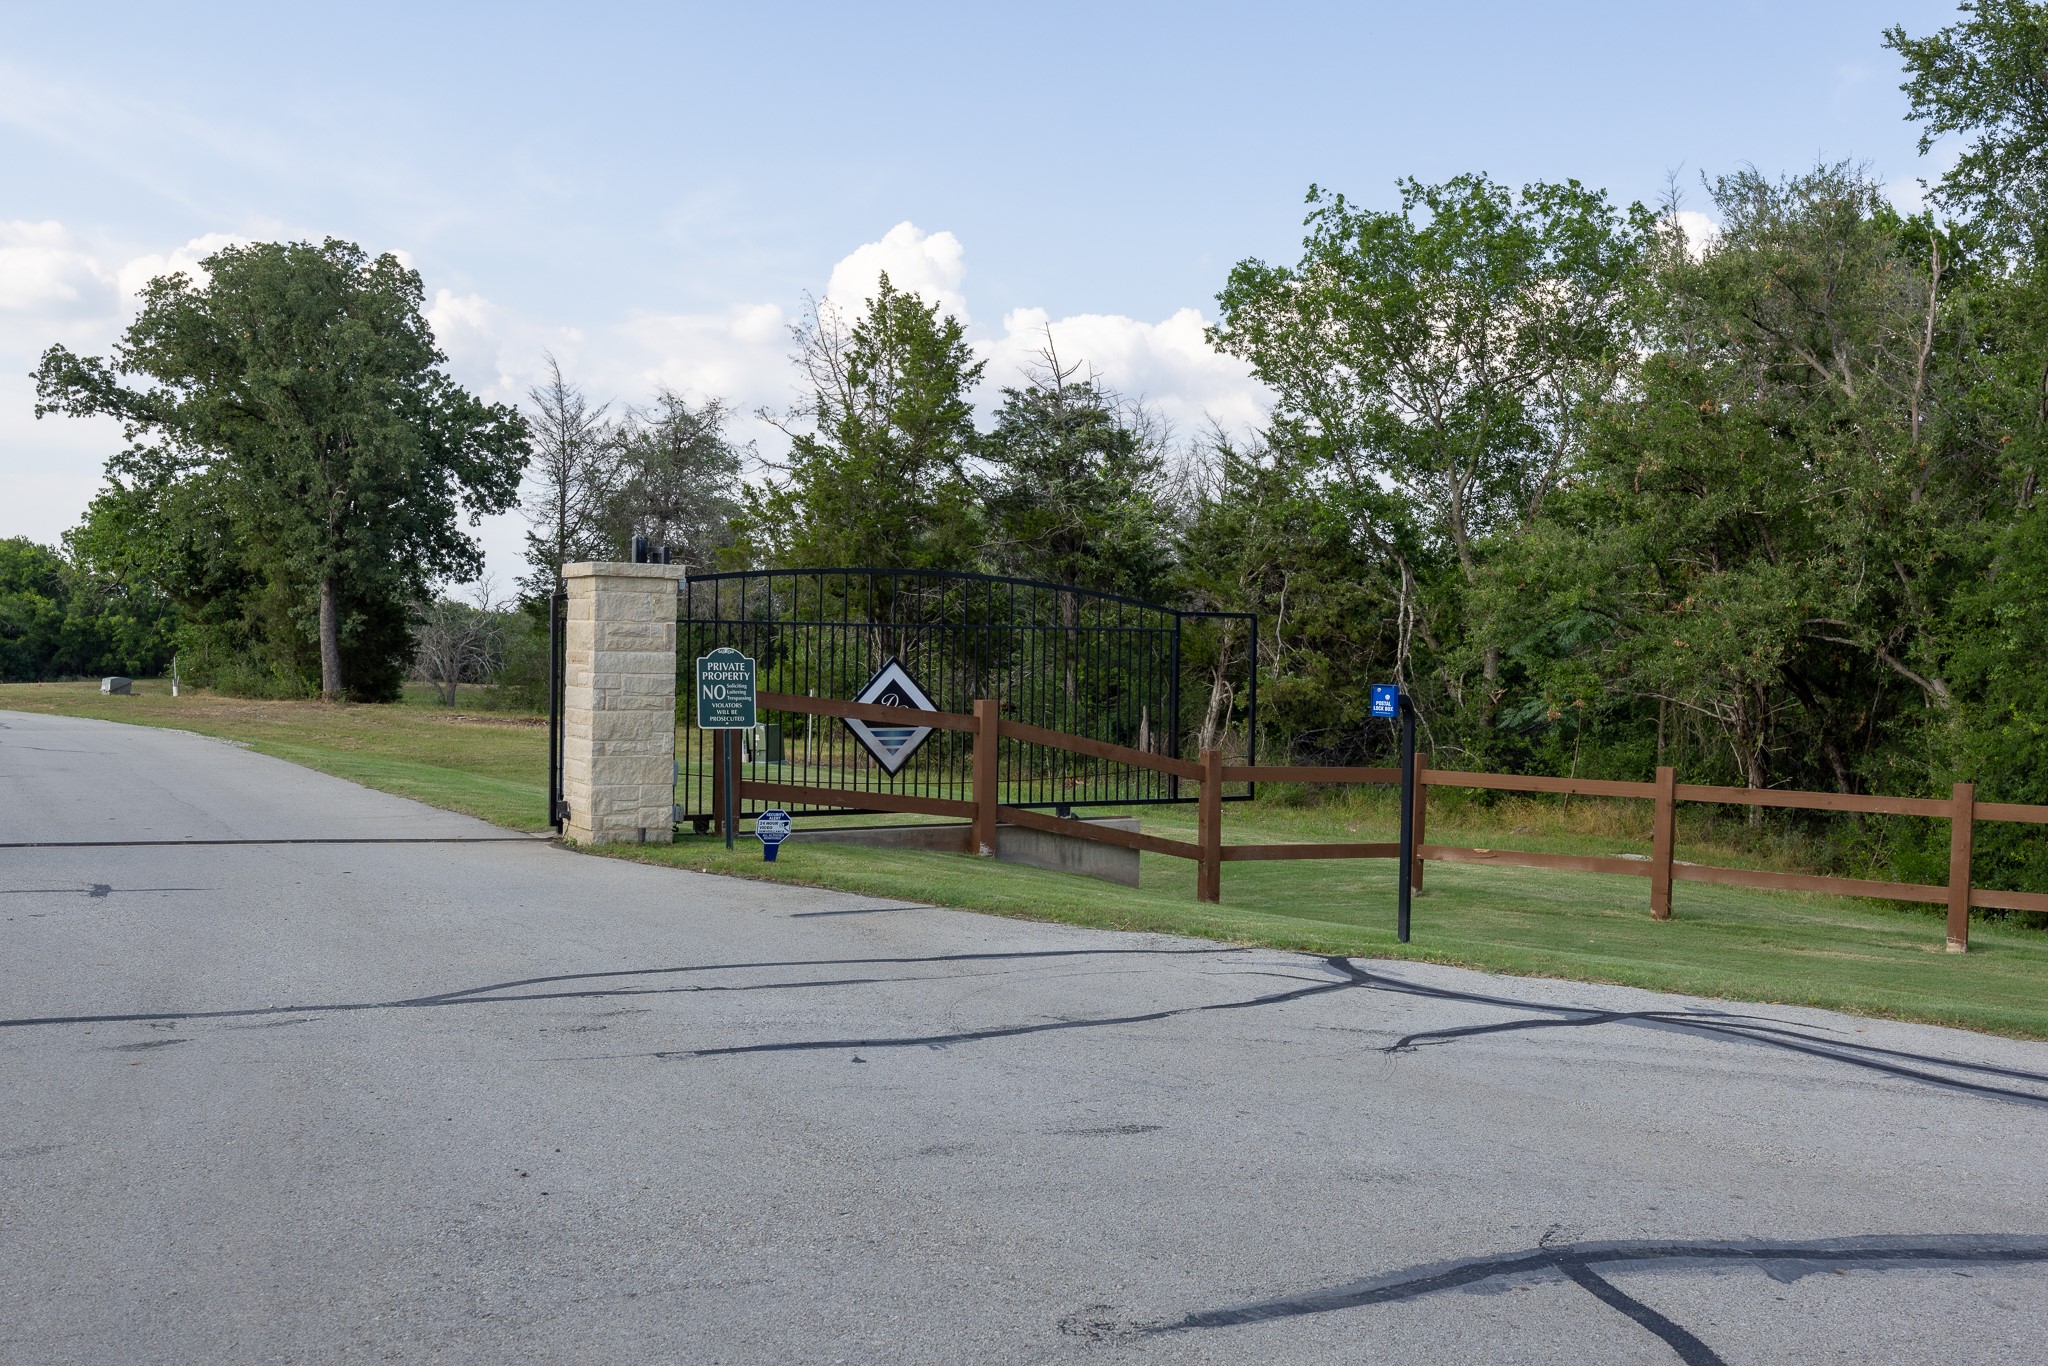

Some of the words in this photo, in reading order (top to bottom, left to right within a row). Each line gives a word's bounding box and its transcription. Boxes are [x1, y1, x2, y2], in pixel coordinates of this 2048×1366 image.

[707, 662, 745, 671] PRIVATE
[702, 671, 750, 680] PROPERTY
[703, 684, 726, 700] NO
